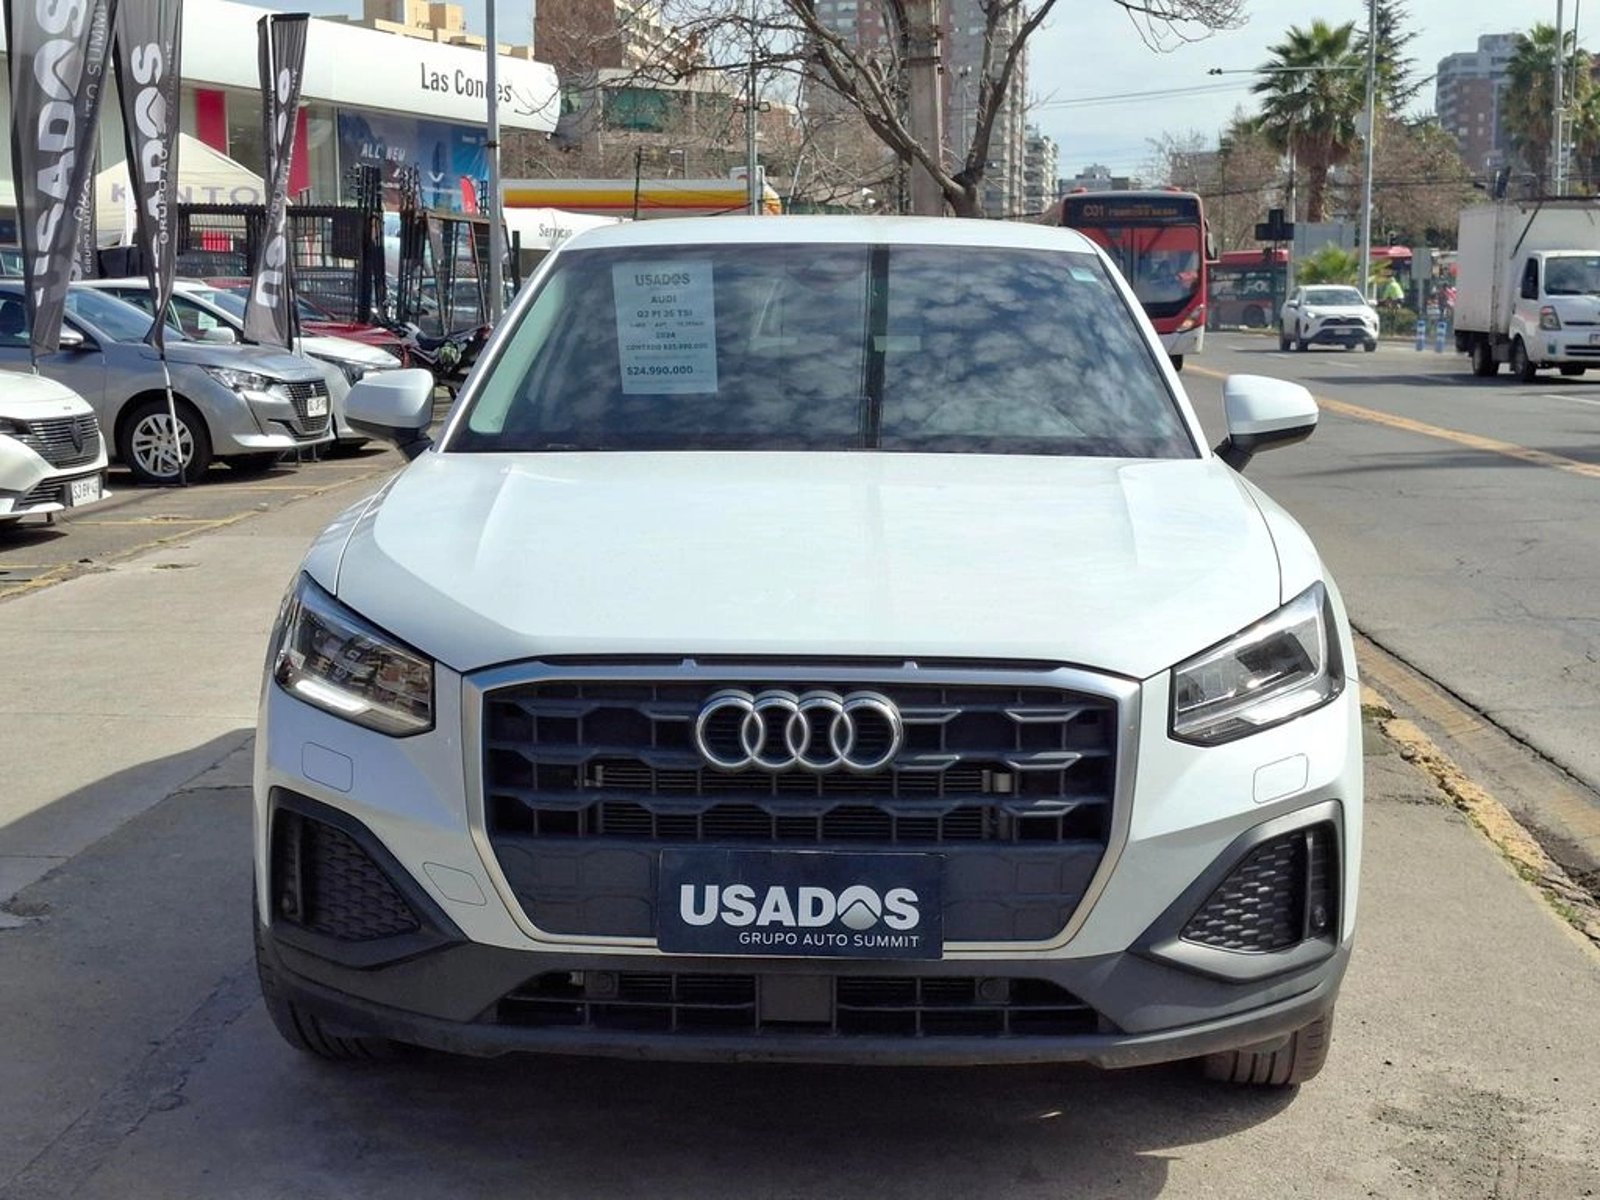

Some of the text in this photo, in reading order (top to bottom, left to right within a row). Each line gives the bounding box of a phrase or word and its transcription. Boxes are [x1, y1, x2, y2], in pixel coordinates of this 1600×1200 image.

[421, 62, 512, 103] Las Cones
[111, 182, 260, 205] KNTO
[635, 273, 691, 286] USADOS
[650, 295, 677, 304] AUDI
[627, 365, 694, 376] $24.990.000
[680, 884, 920, 931] USADOS
[739, 932, 919, 948] GRUPO AUTO SUMMIT
